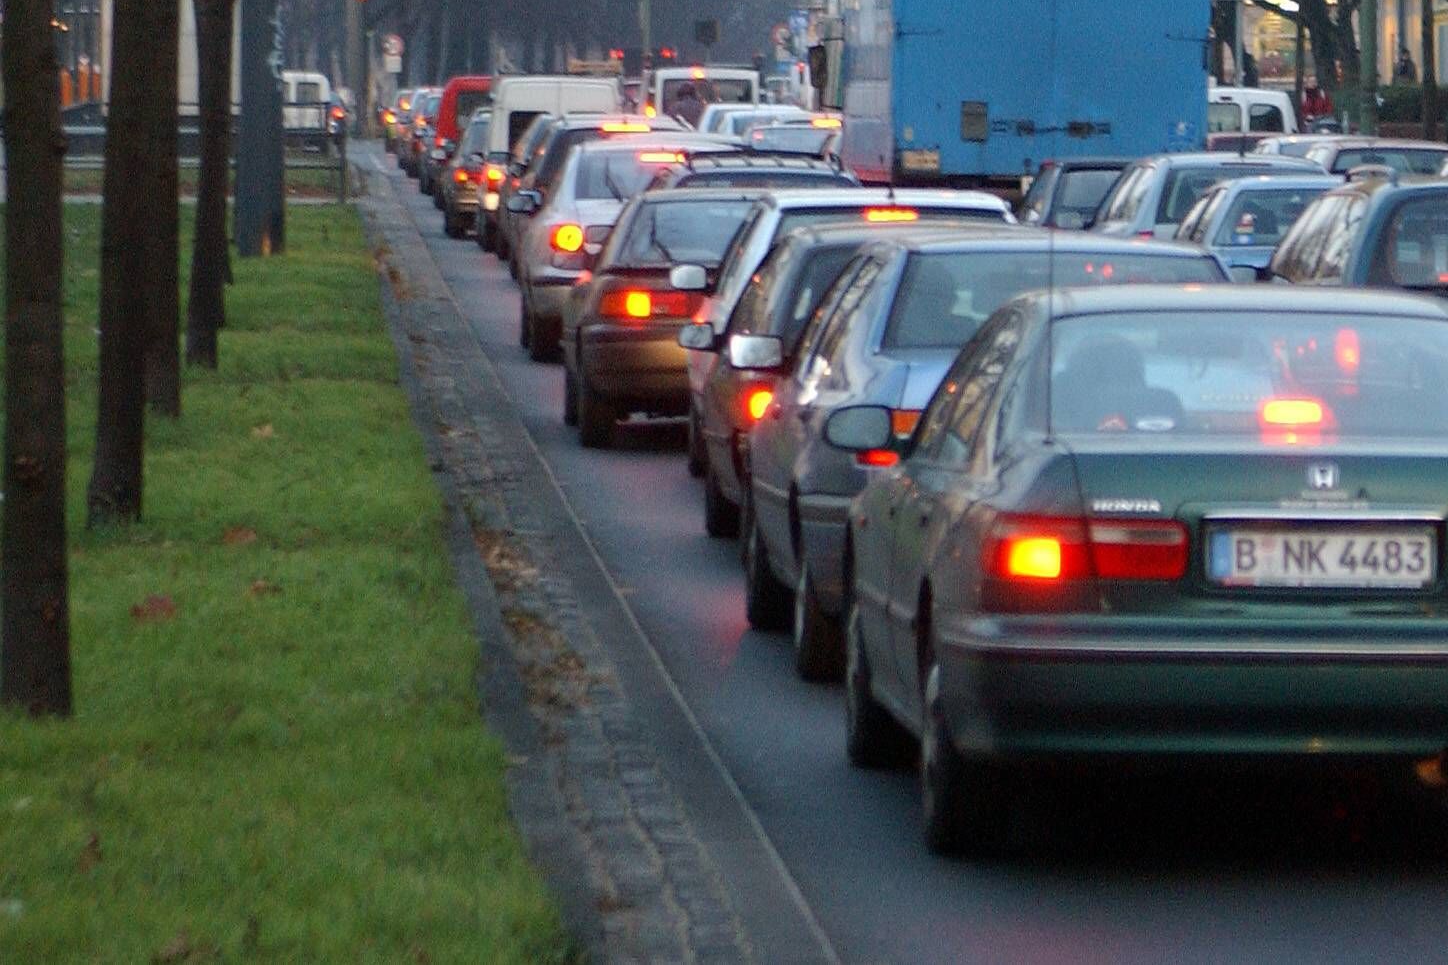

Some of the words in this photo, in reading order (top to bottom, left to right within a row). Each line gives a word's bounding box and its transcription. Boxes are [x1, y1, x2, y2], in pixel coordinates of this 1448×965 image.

[1235, 539, 1257, 571] B
[1282, 539, 1327, 572] NK
[1338, 540, 1426, 573] 4483
